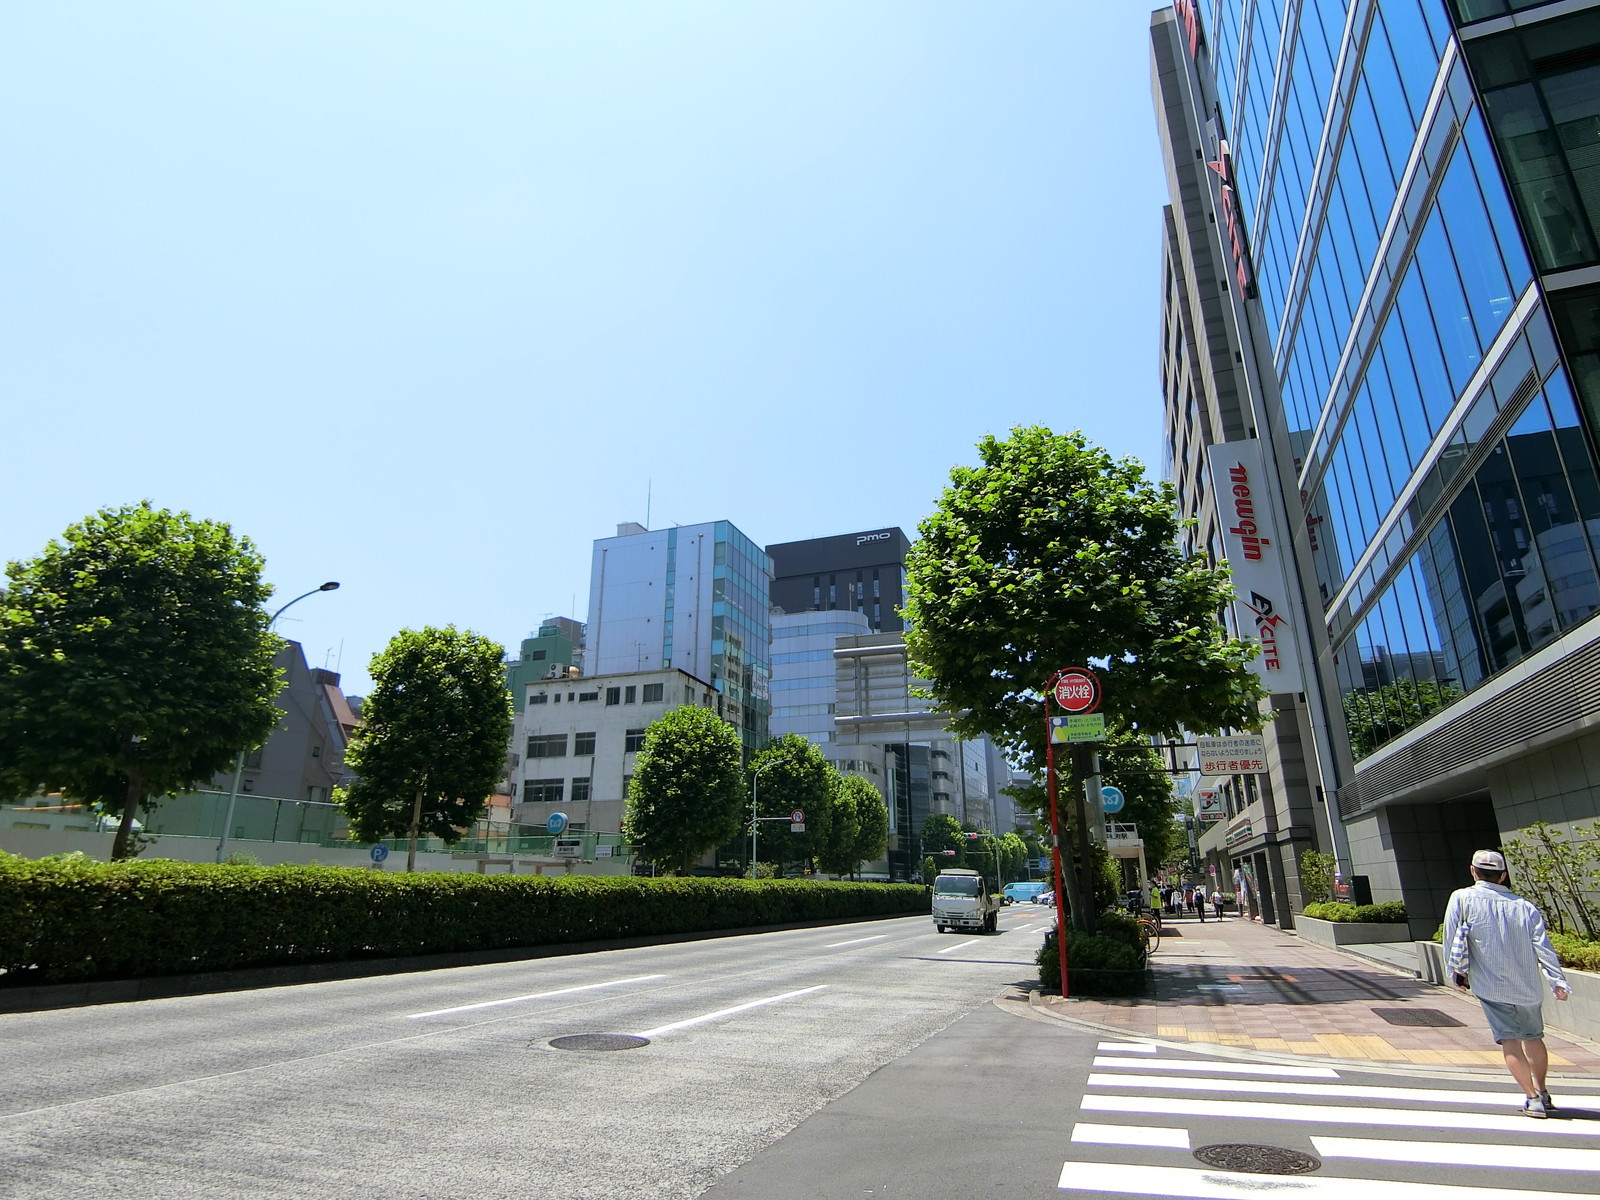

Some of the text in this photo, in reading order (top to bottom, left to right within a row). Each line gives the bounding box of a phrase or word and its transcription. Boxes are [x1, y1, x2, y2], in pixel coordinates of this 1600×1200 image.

[1059, 685, 1090, 699] 消火栓
[1200, 739, 1261, 748] 自転車は歩行者の迷惑に
[1204, 760, 1263, 771] 歩行者優先
